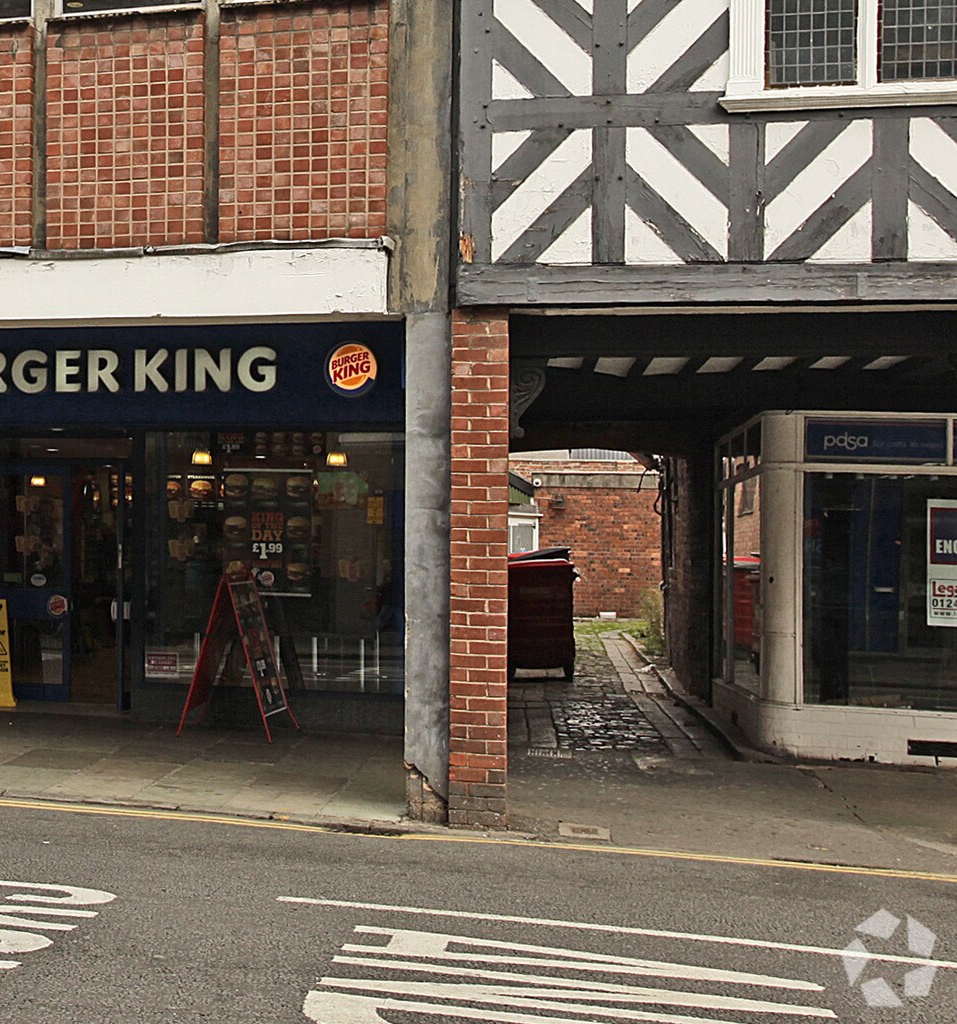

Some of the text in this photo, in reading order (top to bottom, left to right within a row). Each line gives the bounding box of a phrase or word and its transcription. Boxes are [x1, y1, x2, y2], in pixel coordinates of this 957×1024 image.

[331, 351, 370, 369] BURGER
[134, 346, 277, 393] KING
[332, 360, 371, 384] KING
[823, 432, 868, 451] pdsa
[251, 511, 284, 522] KING
[251, 529, 283, 541] DAY
[252, 542, 283, 560] £1.99
